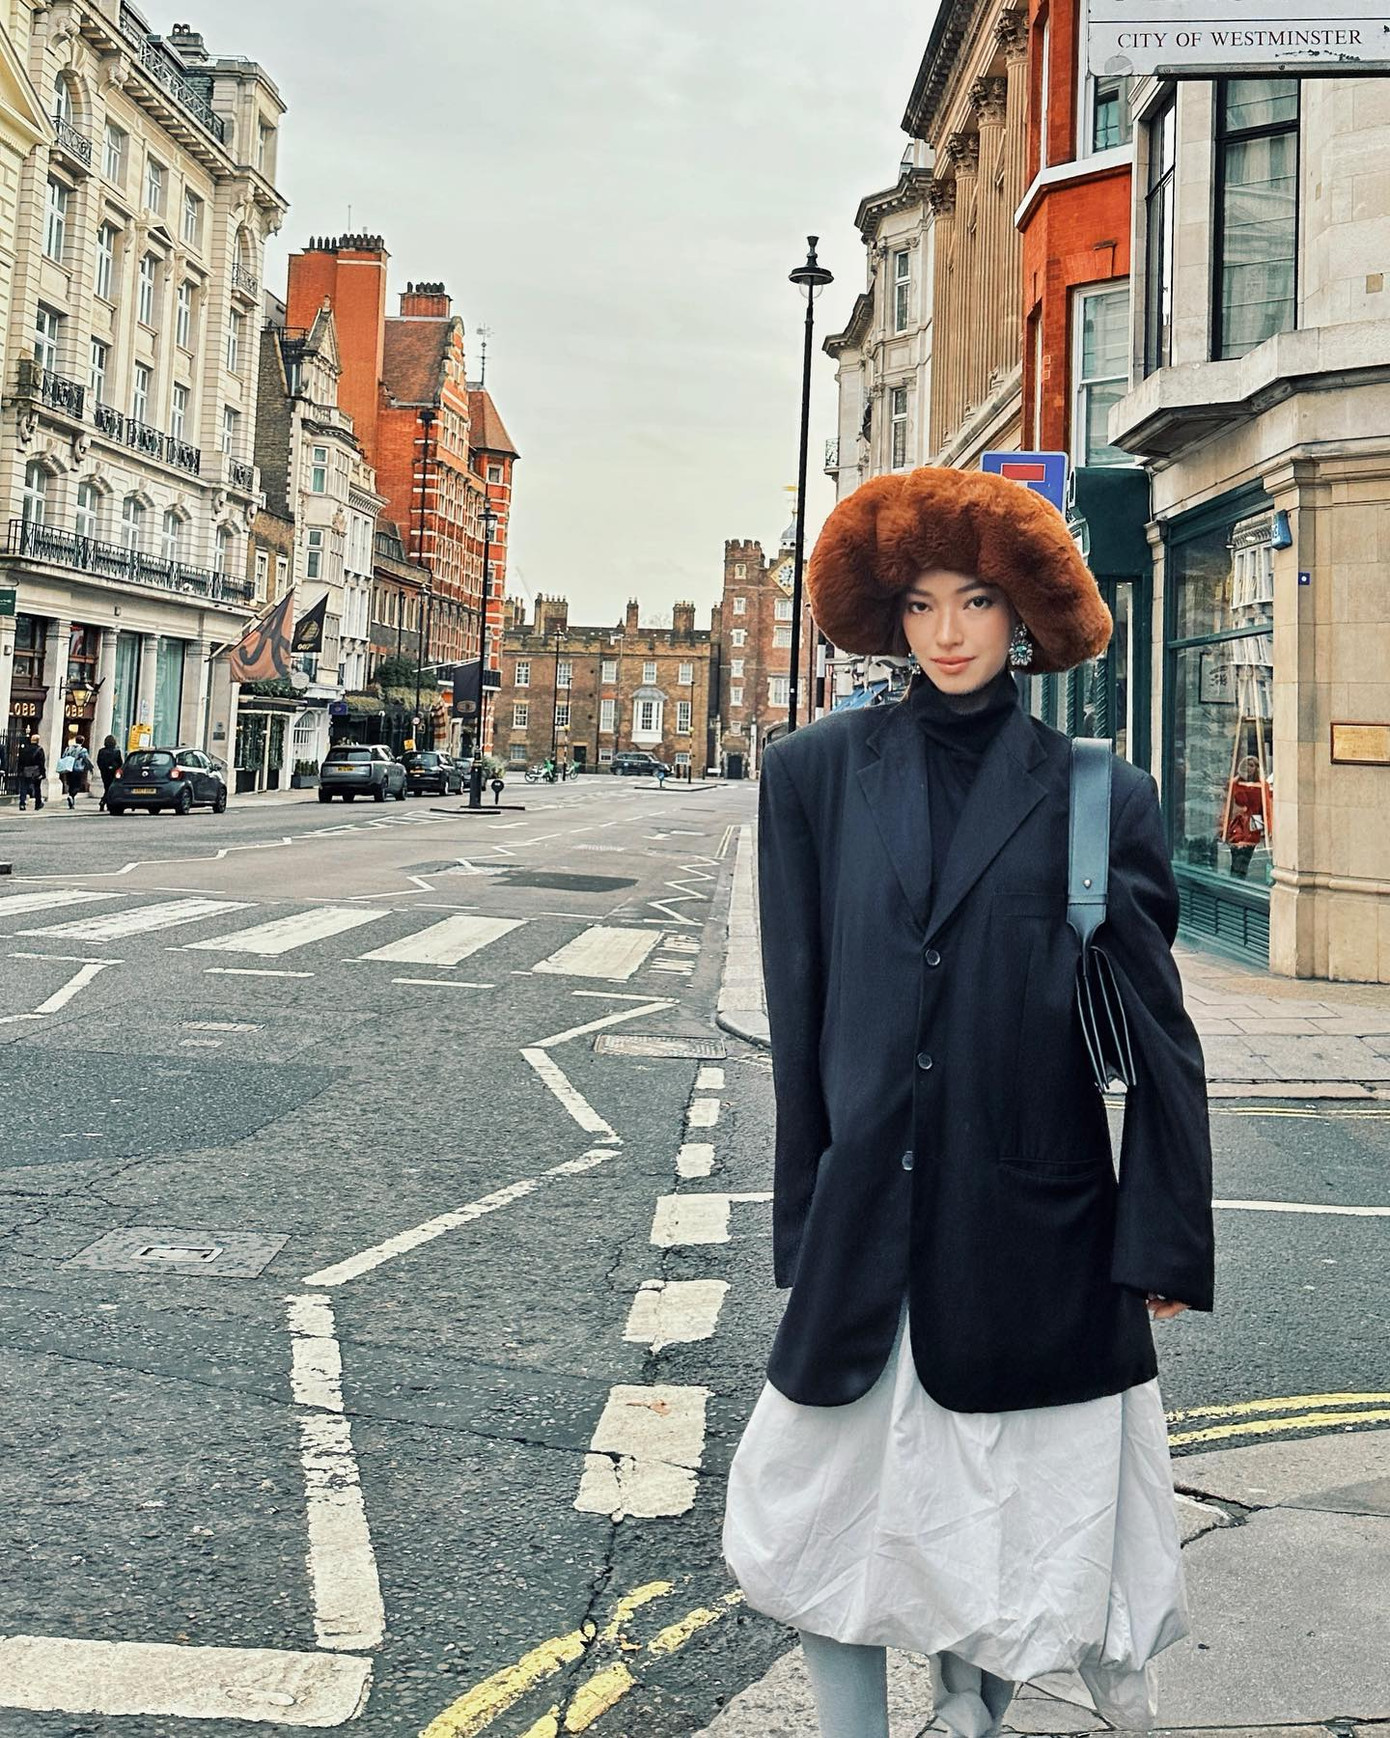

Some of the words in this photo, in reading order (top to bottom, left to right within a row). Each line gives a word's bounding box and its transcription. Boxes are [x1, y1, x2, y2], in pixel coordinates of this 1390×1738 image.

[1117, 32, 1167, 48] CITY
[1176, 32, 1203, 47] OF
[1210, 29, 1362, 47] WESTMINSTER
